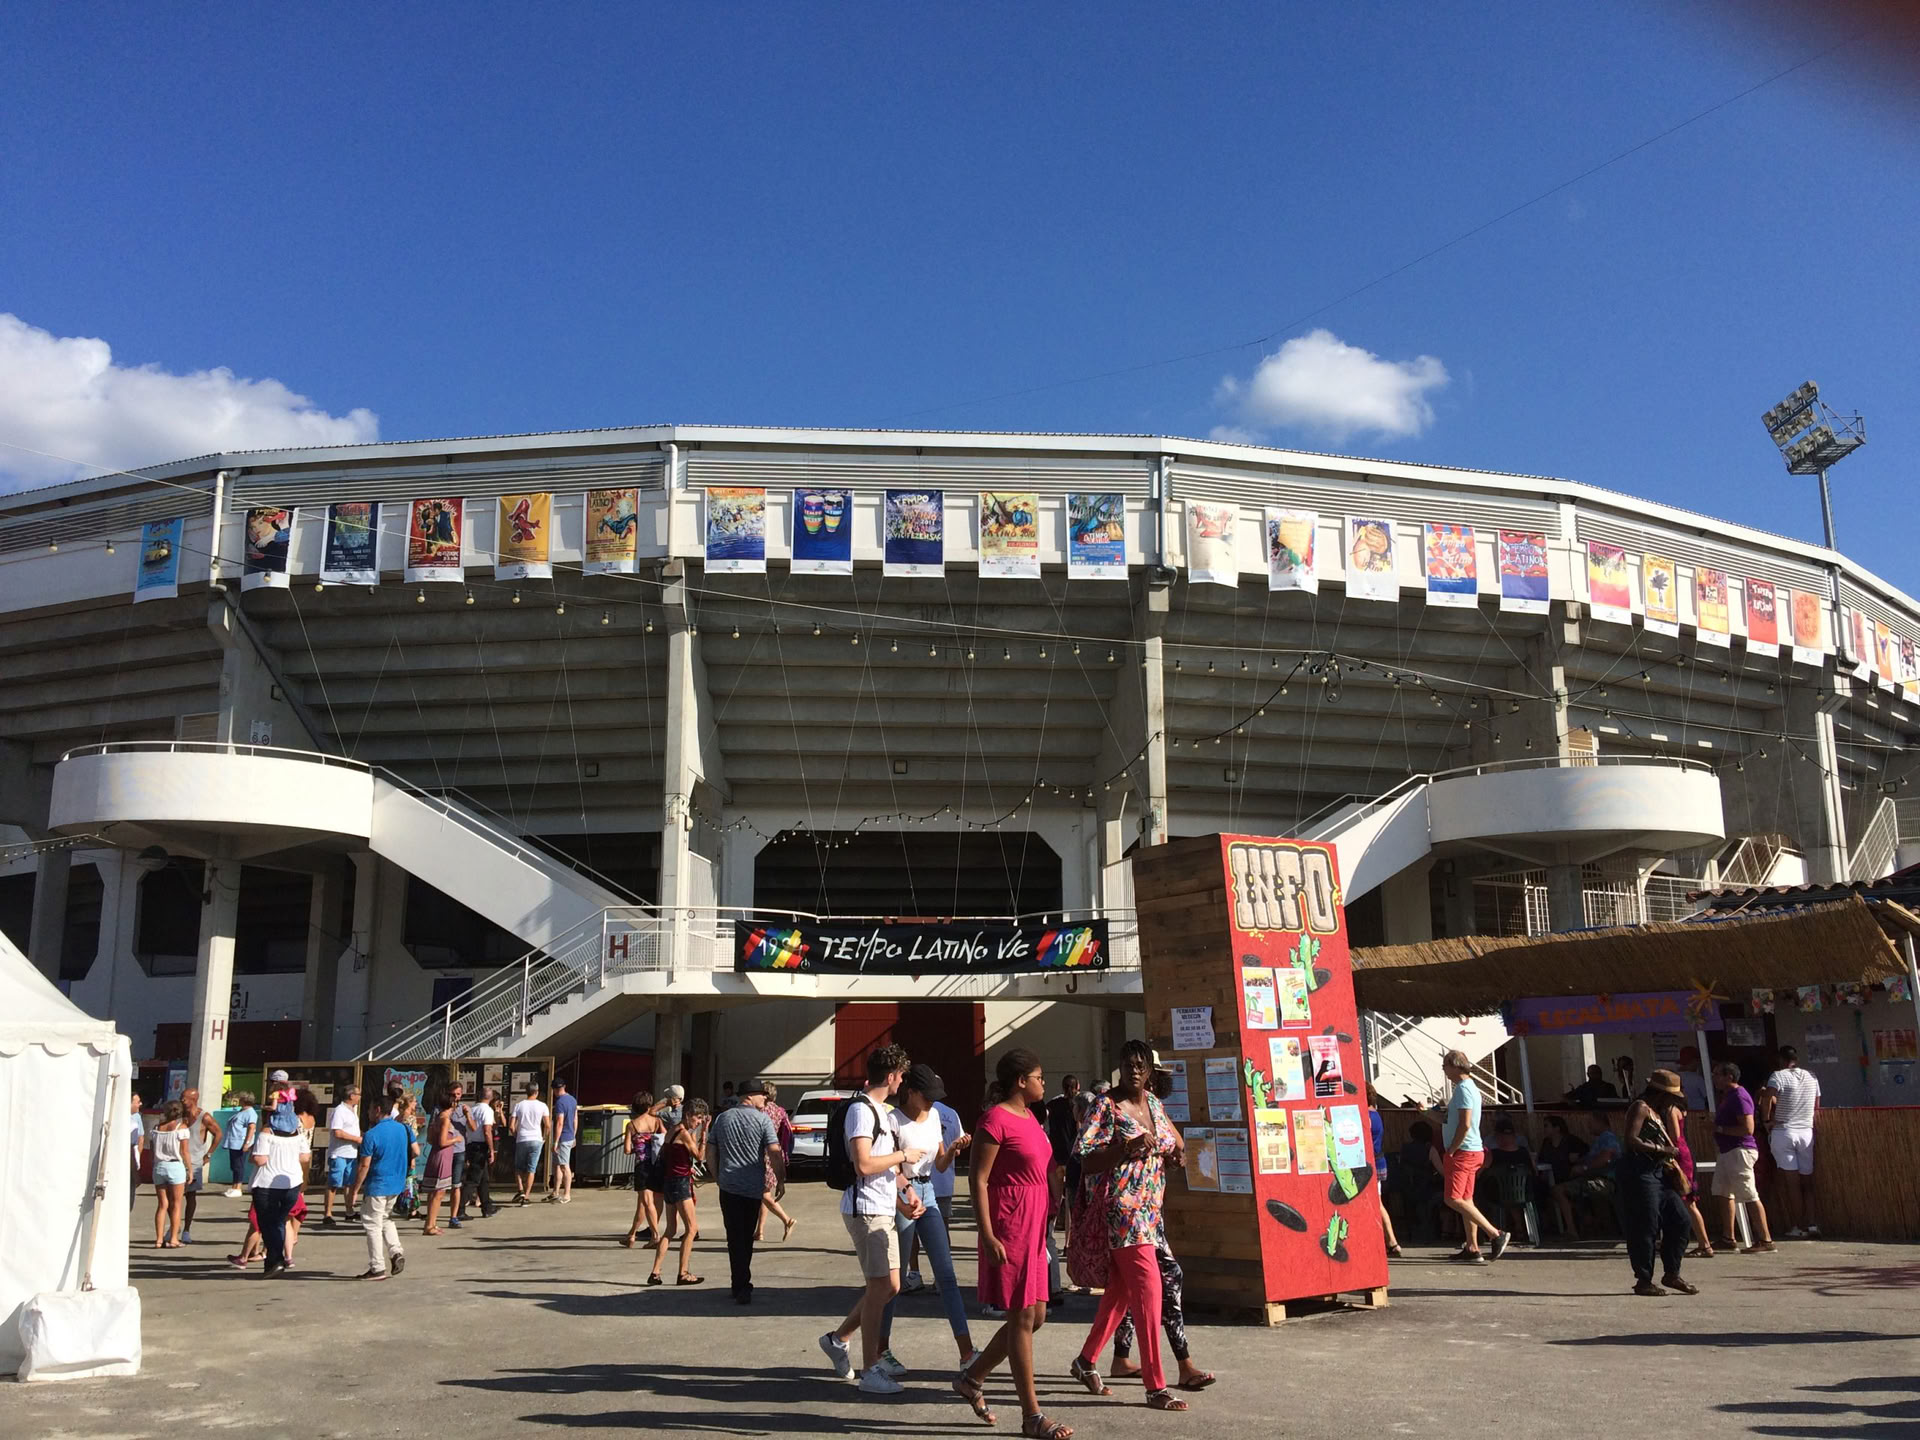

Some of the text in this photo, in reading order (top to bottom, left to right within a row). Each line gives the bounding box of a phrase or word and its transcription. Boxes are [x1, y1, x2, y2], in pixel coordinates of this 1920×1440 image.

[893, 495, 929, 507] TEMPO
[1230, 845, 1338, 932] INFO
[609, 934, 629, 959] H
[819, 928, 903, 971] TEMPO
[908, 931, 988, 964] LATINO
[997, 929, 1030, 960] VIC
[1065, 974, 1077, 994] J
[211, 1019, 225, 1041] H
